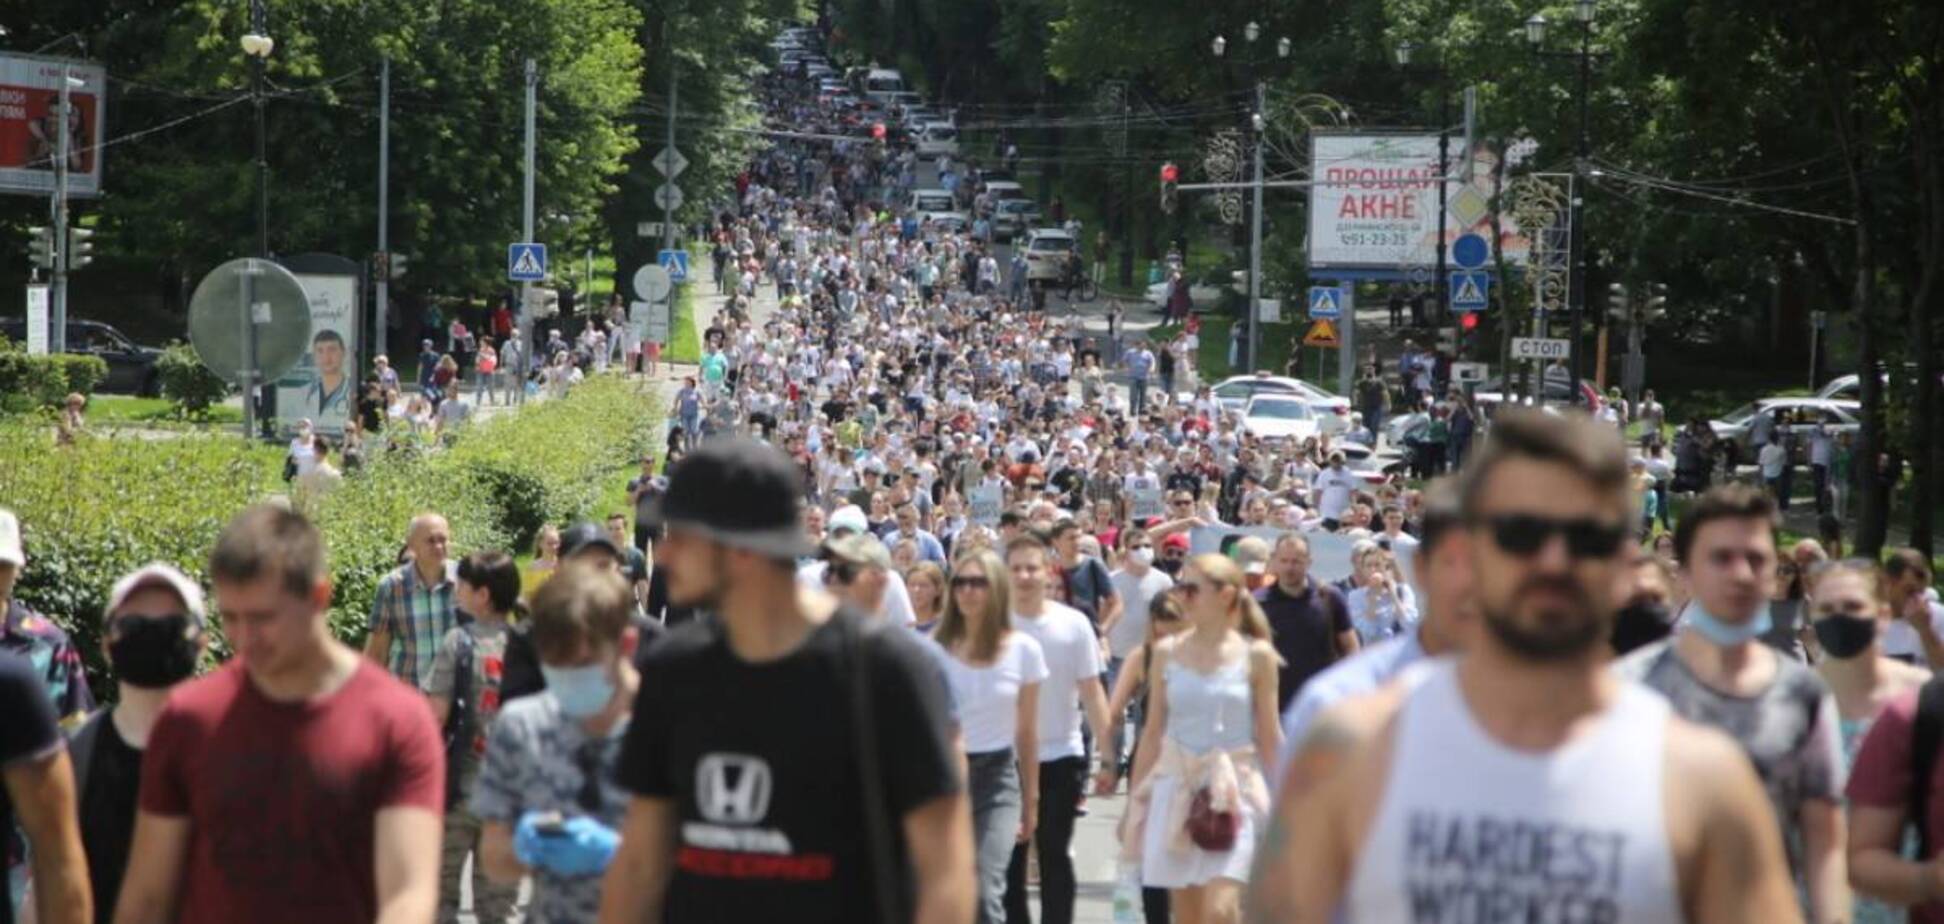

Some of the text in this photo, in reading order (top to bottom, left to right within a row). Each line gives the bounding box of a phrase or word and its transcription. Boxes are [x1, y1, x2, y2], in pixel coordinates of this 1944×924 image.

[1326, 164, 1442, 190] ПРОЩАЙ
[1339, 194, 1416, 219] АКНЕ
[1520, 341, 1562, 355] СТОП
[1406, 808, 1628, 892] HARDEST
